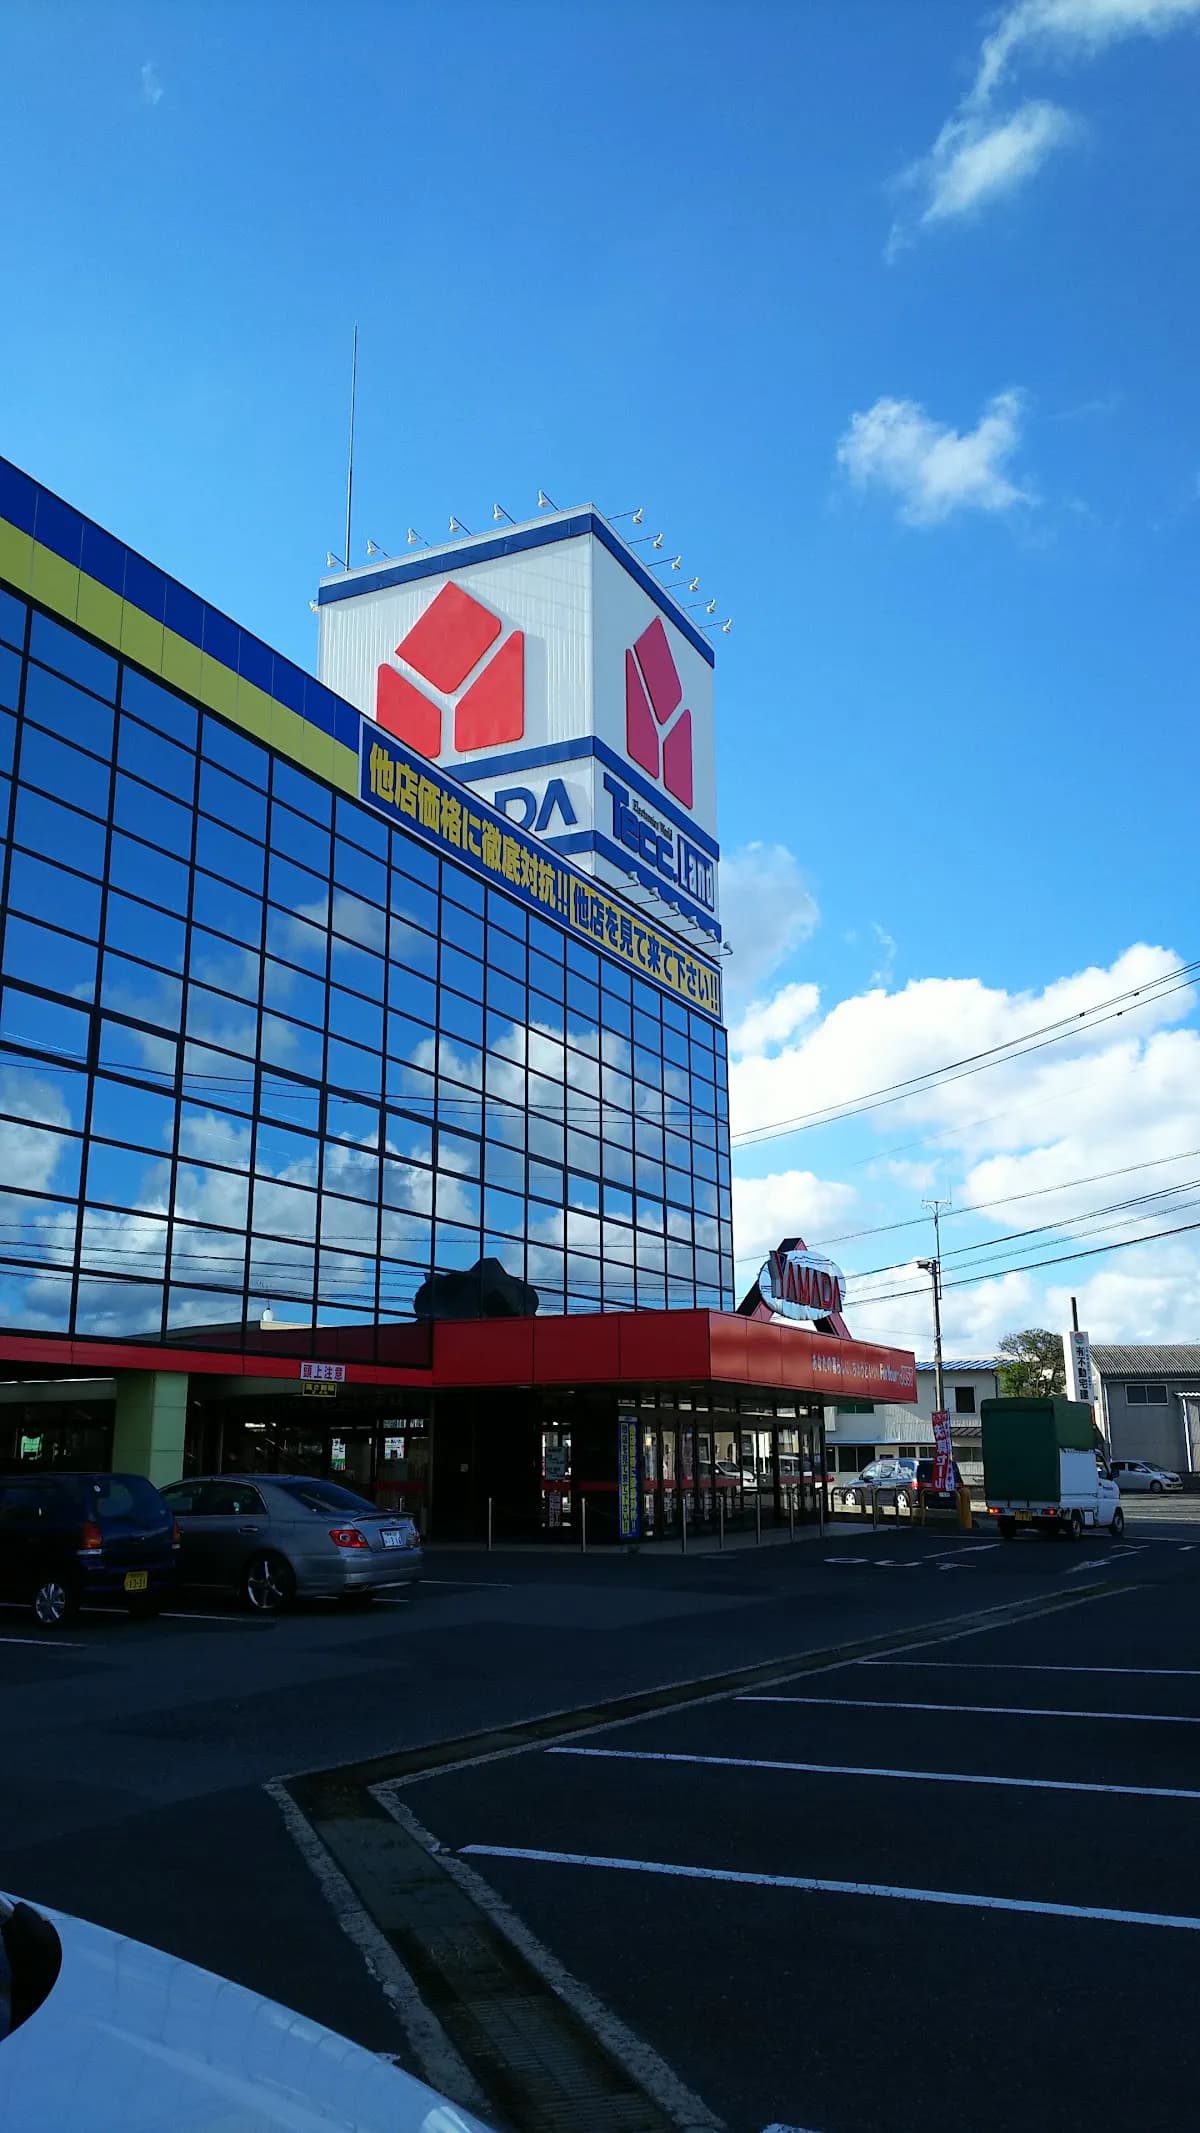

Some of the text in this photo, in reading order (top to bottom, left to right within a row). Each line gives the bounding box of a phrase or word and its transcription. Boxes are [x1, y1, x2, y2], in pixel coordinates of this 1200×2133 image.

[769, 1251, 842, 1312] YAMADA
[303, 1364, 344, 1380] 頭上注意
